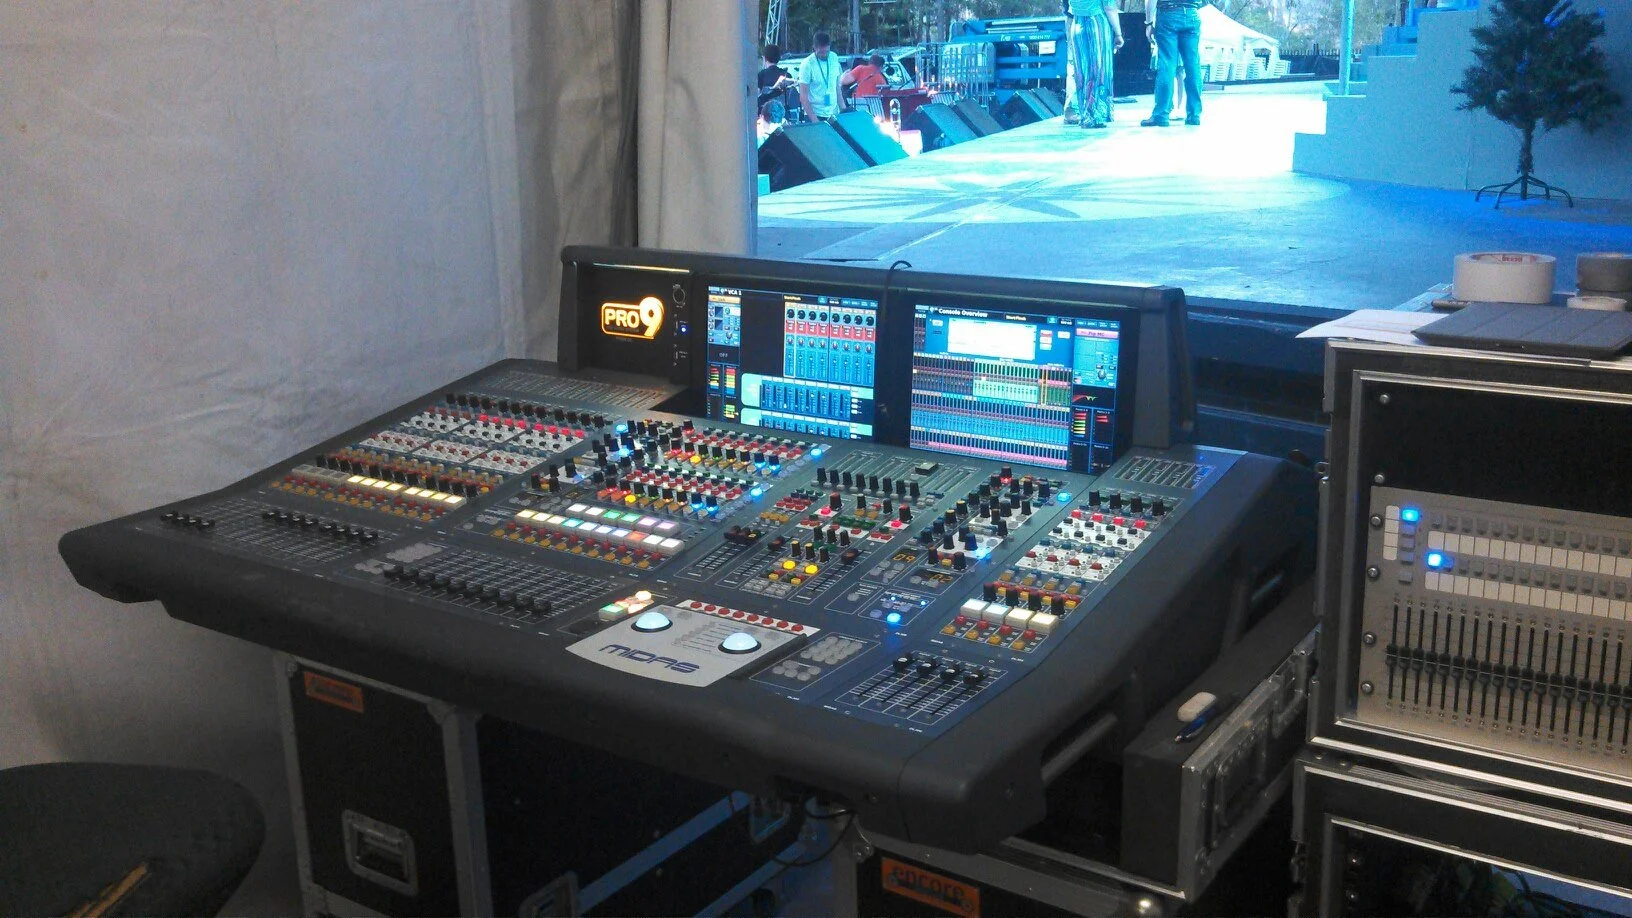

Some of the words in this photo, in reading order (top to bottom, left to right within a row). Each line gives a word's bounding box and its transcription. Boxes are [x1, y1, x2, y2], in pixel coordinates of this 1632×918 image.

[604, 308, 640, 328] PRO
[640, 296, 665, 338] 9
[598, 644, 700, 673] MIDAS
